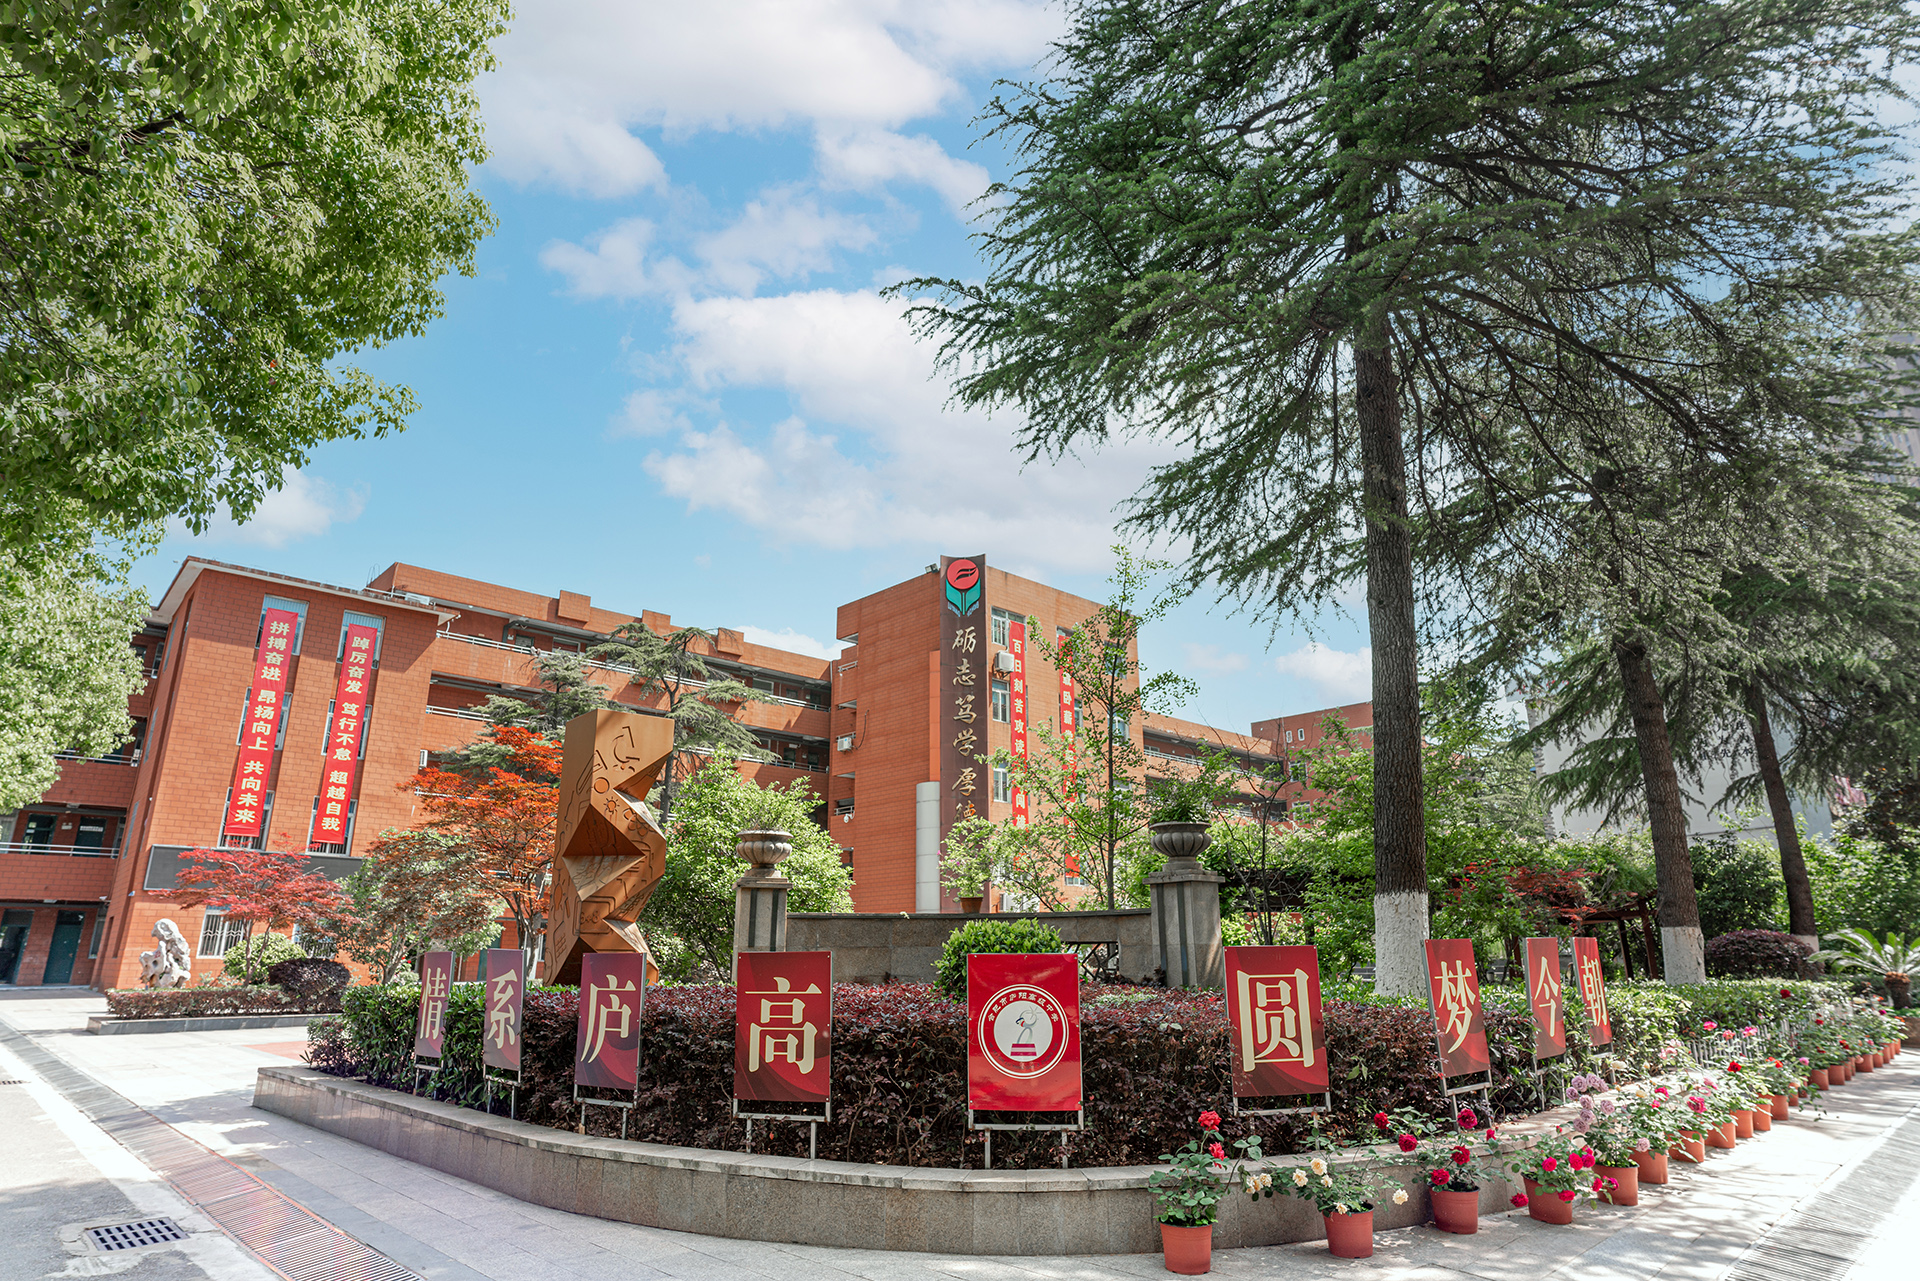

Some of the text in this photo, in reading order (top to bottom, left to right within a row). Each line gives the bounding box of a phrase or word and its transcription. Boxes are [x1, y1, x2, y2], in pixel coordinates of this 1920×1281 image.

[234, 621, 290, 823] 拼搏奋进 昂扬向上 共向未来
[321, 636, 370, 831] 踔厉奋发 笃行不怠 超越自我
[420, 967, 447, 1040] 情
[487, 969, 518, 1049] 系
[580, 975, 637, 1064] 庐
[745, 976, 823, 1075] 高
[1237, 968, 1315, 1073] 圆
[1434, 959, 1476, 1054] 梦
[1534, 956, 1560, 1038] 今
[1581, 955, 1608, 1027] 朝
